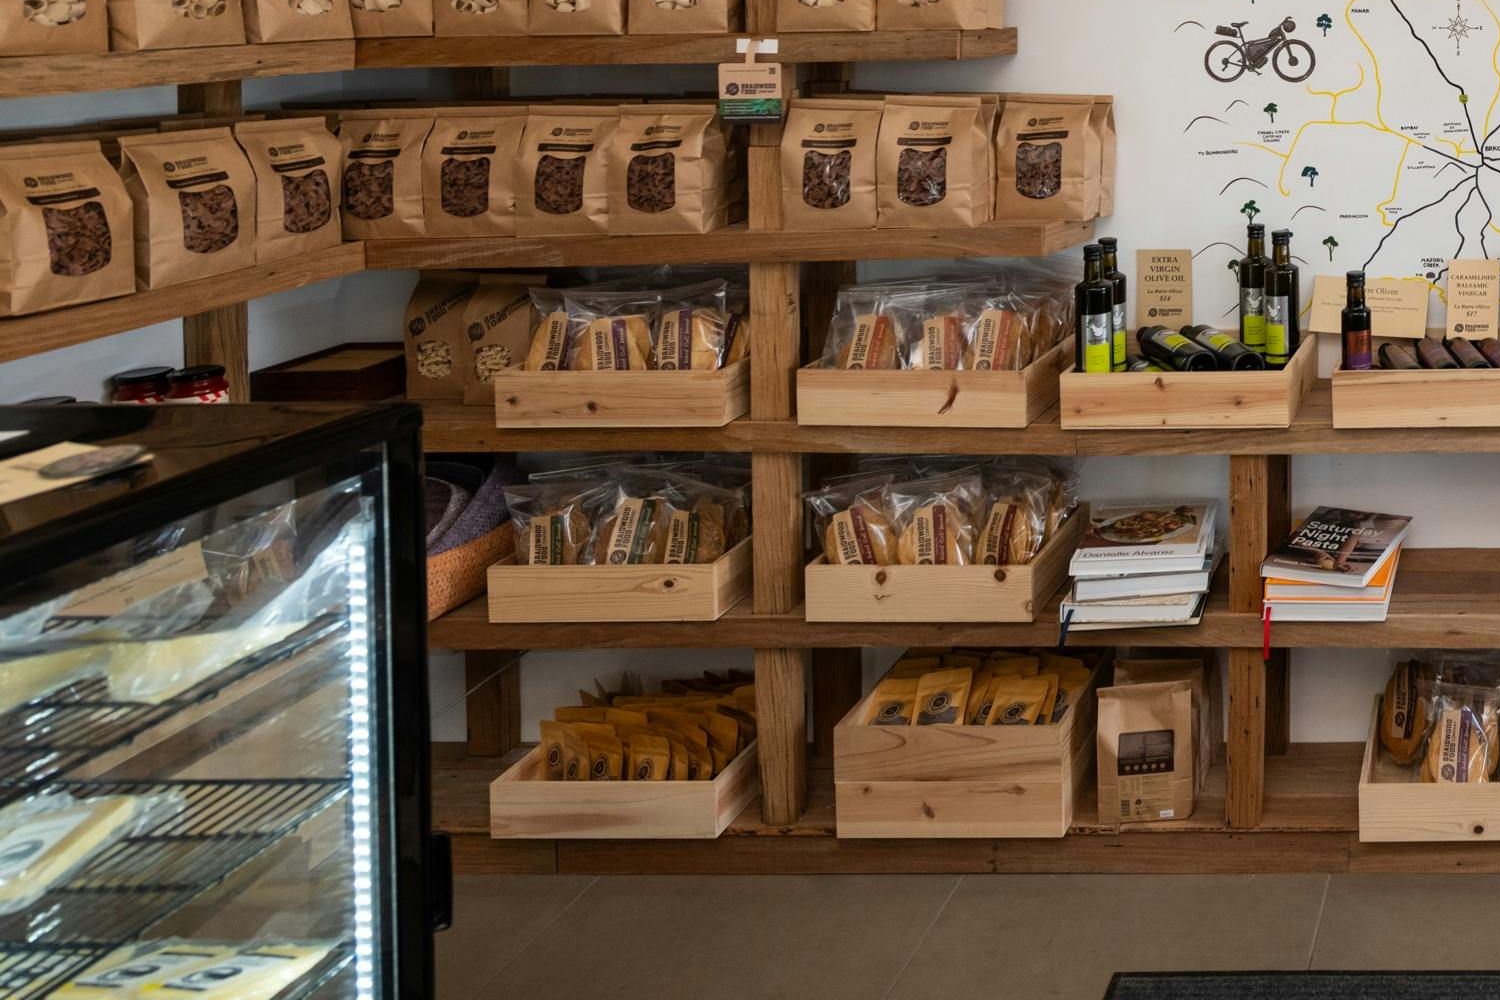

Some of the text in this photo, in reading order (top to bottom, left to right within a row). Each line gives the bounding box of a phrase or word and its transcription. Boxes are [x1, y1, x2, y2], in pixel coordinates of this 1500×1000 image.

[1144, 274, 1185, 282] OLIVE OIL
[1375, 287, 1398, 295] Olives
[852, 324, 866, 361] BRAIDWOOD
[979, 318, 992, 357] BRAIDWOOD
[858, 345, 868, 361] FOOD
[986, 341, 995, 359] FOOD
[614, 507, 631, 548] BRAIDWOOD
[1300, 528, 1349, 543] Night
[1307, 521, 1384, 537] Saturday
[621, 529, 633, 548] FOOD
[669, 518, 680, 557] BRAIDWOOD
[1291, 536, 1340, 550] Pasta
[676, 541, 684, 559] FOOD
[1083, 549, 1175, 559] Danielle Alvarez
[1442, 719, 1453, 761] BRAIDWOOD
